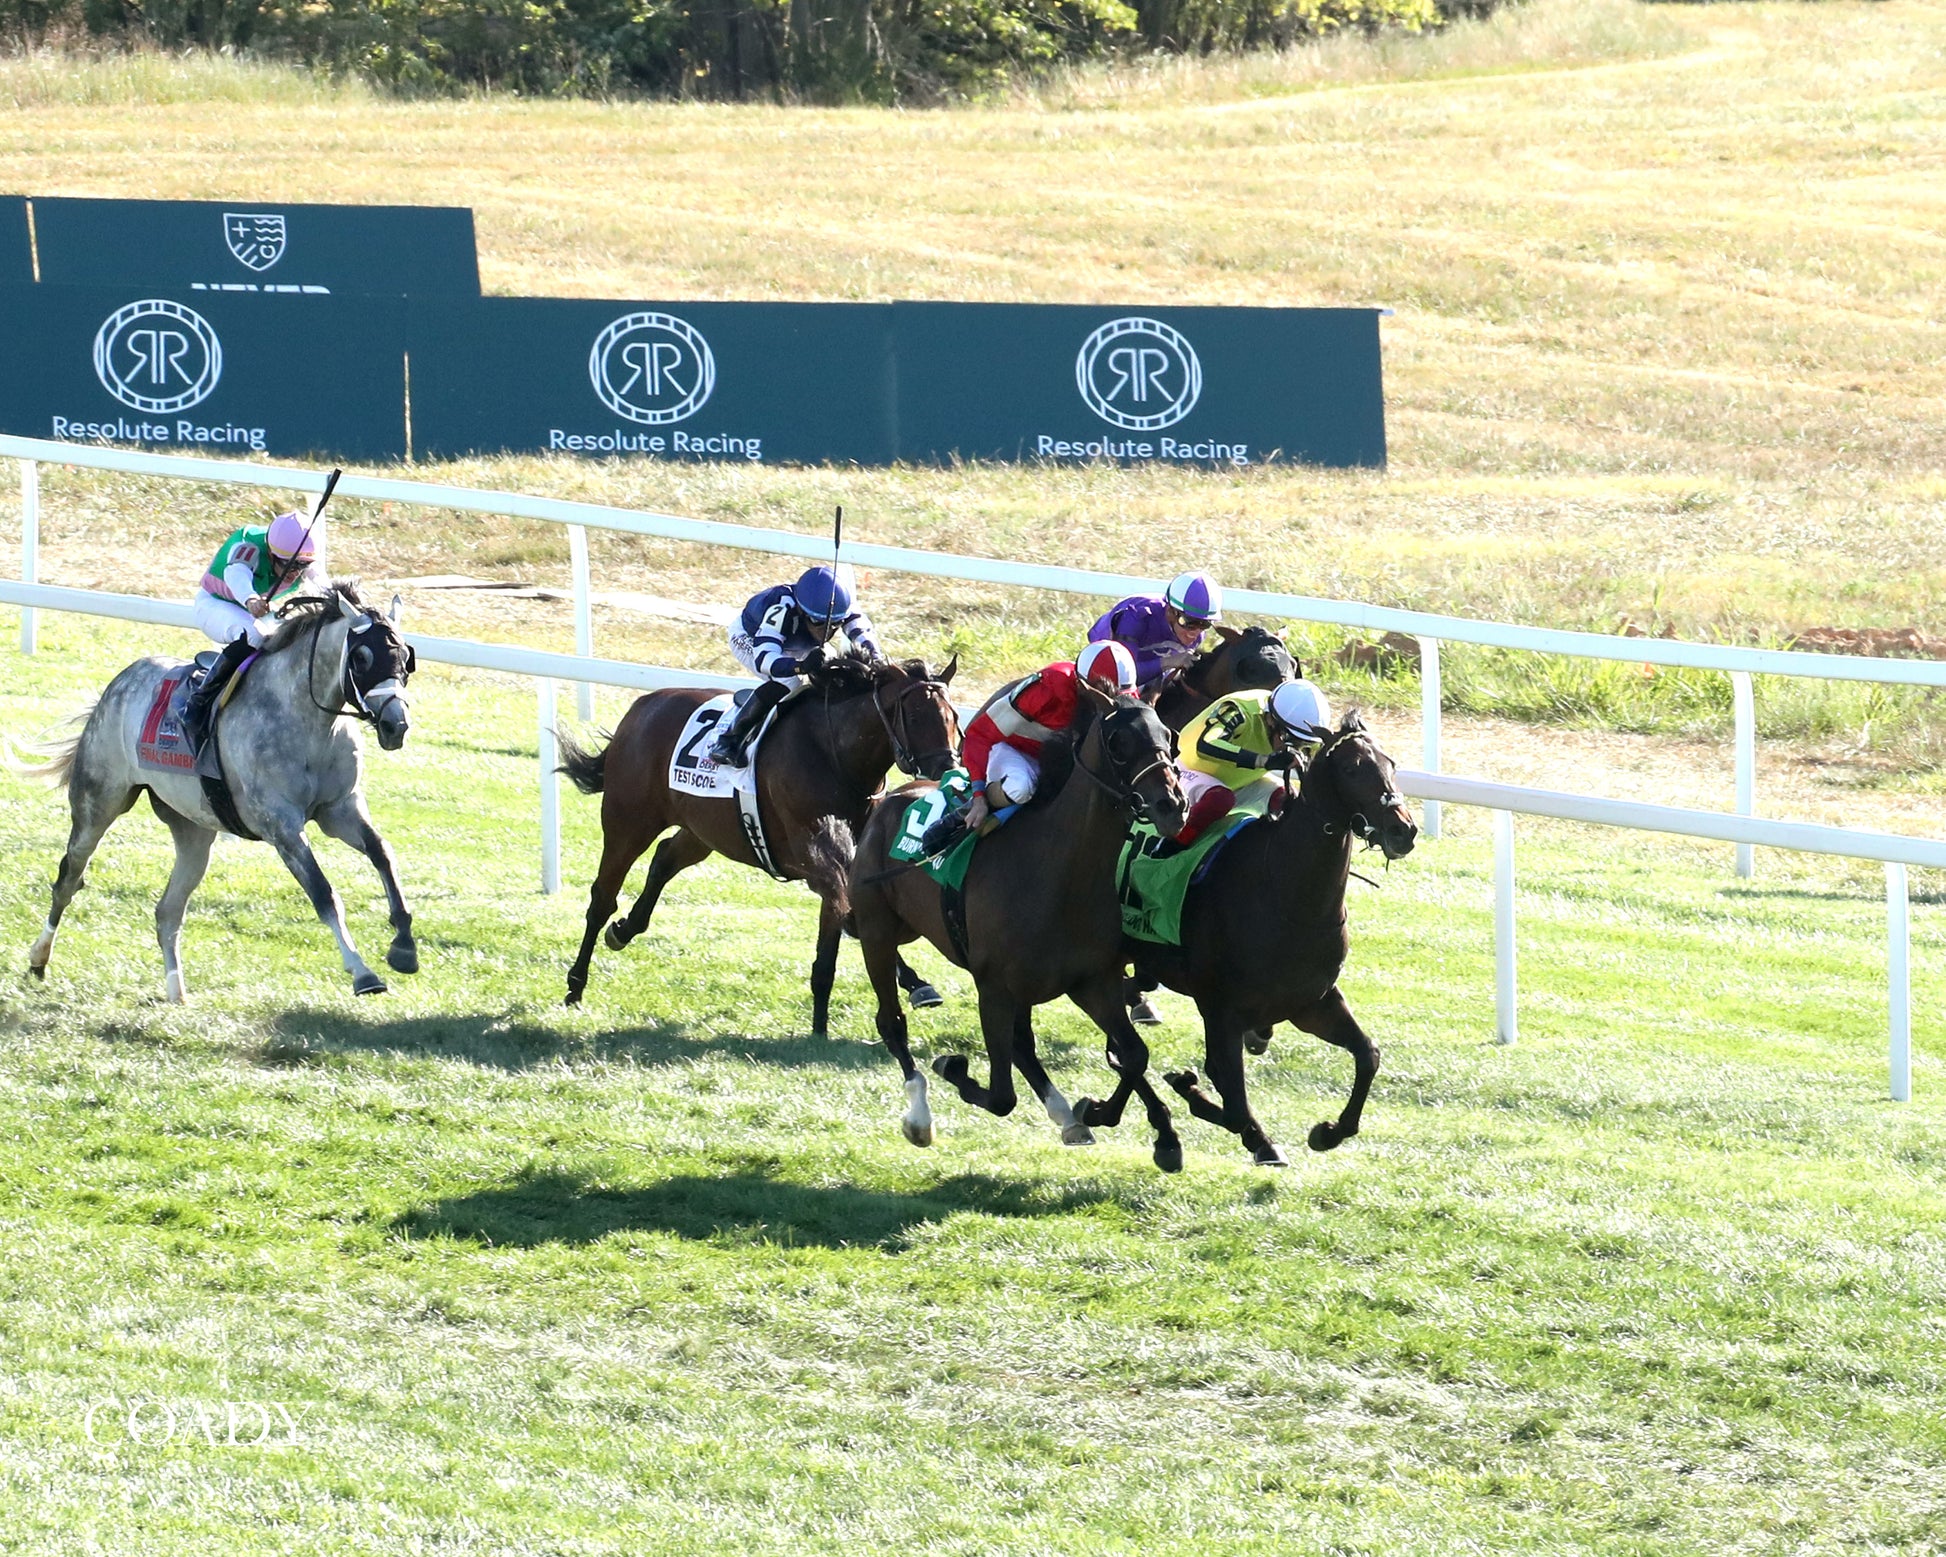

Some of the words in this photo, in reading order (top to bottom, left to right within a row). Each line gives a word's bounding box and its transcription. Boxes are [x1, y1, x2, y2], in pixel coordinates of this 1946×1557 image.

[52, 415, 169, 441] Resolute
[177, 420, 266, 449] Racing
[550, 429, 665, 452] Resolute
[673, 431, 761, 459] Racing
[1037, 435, 1153, 458] Resolute
[1161, 437, 1248, 463] Racing
[766, 606, 783, 626] 2
[675, 708, 724, 769] 2
